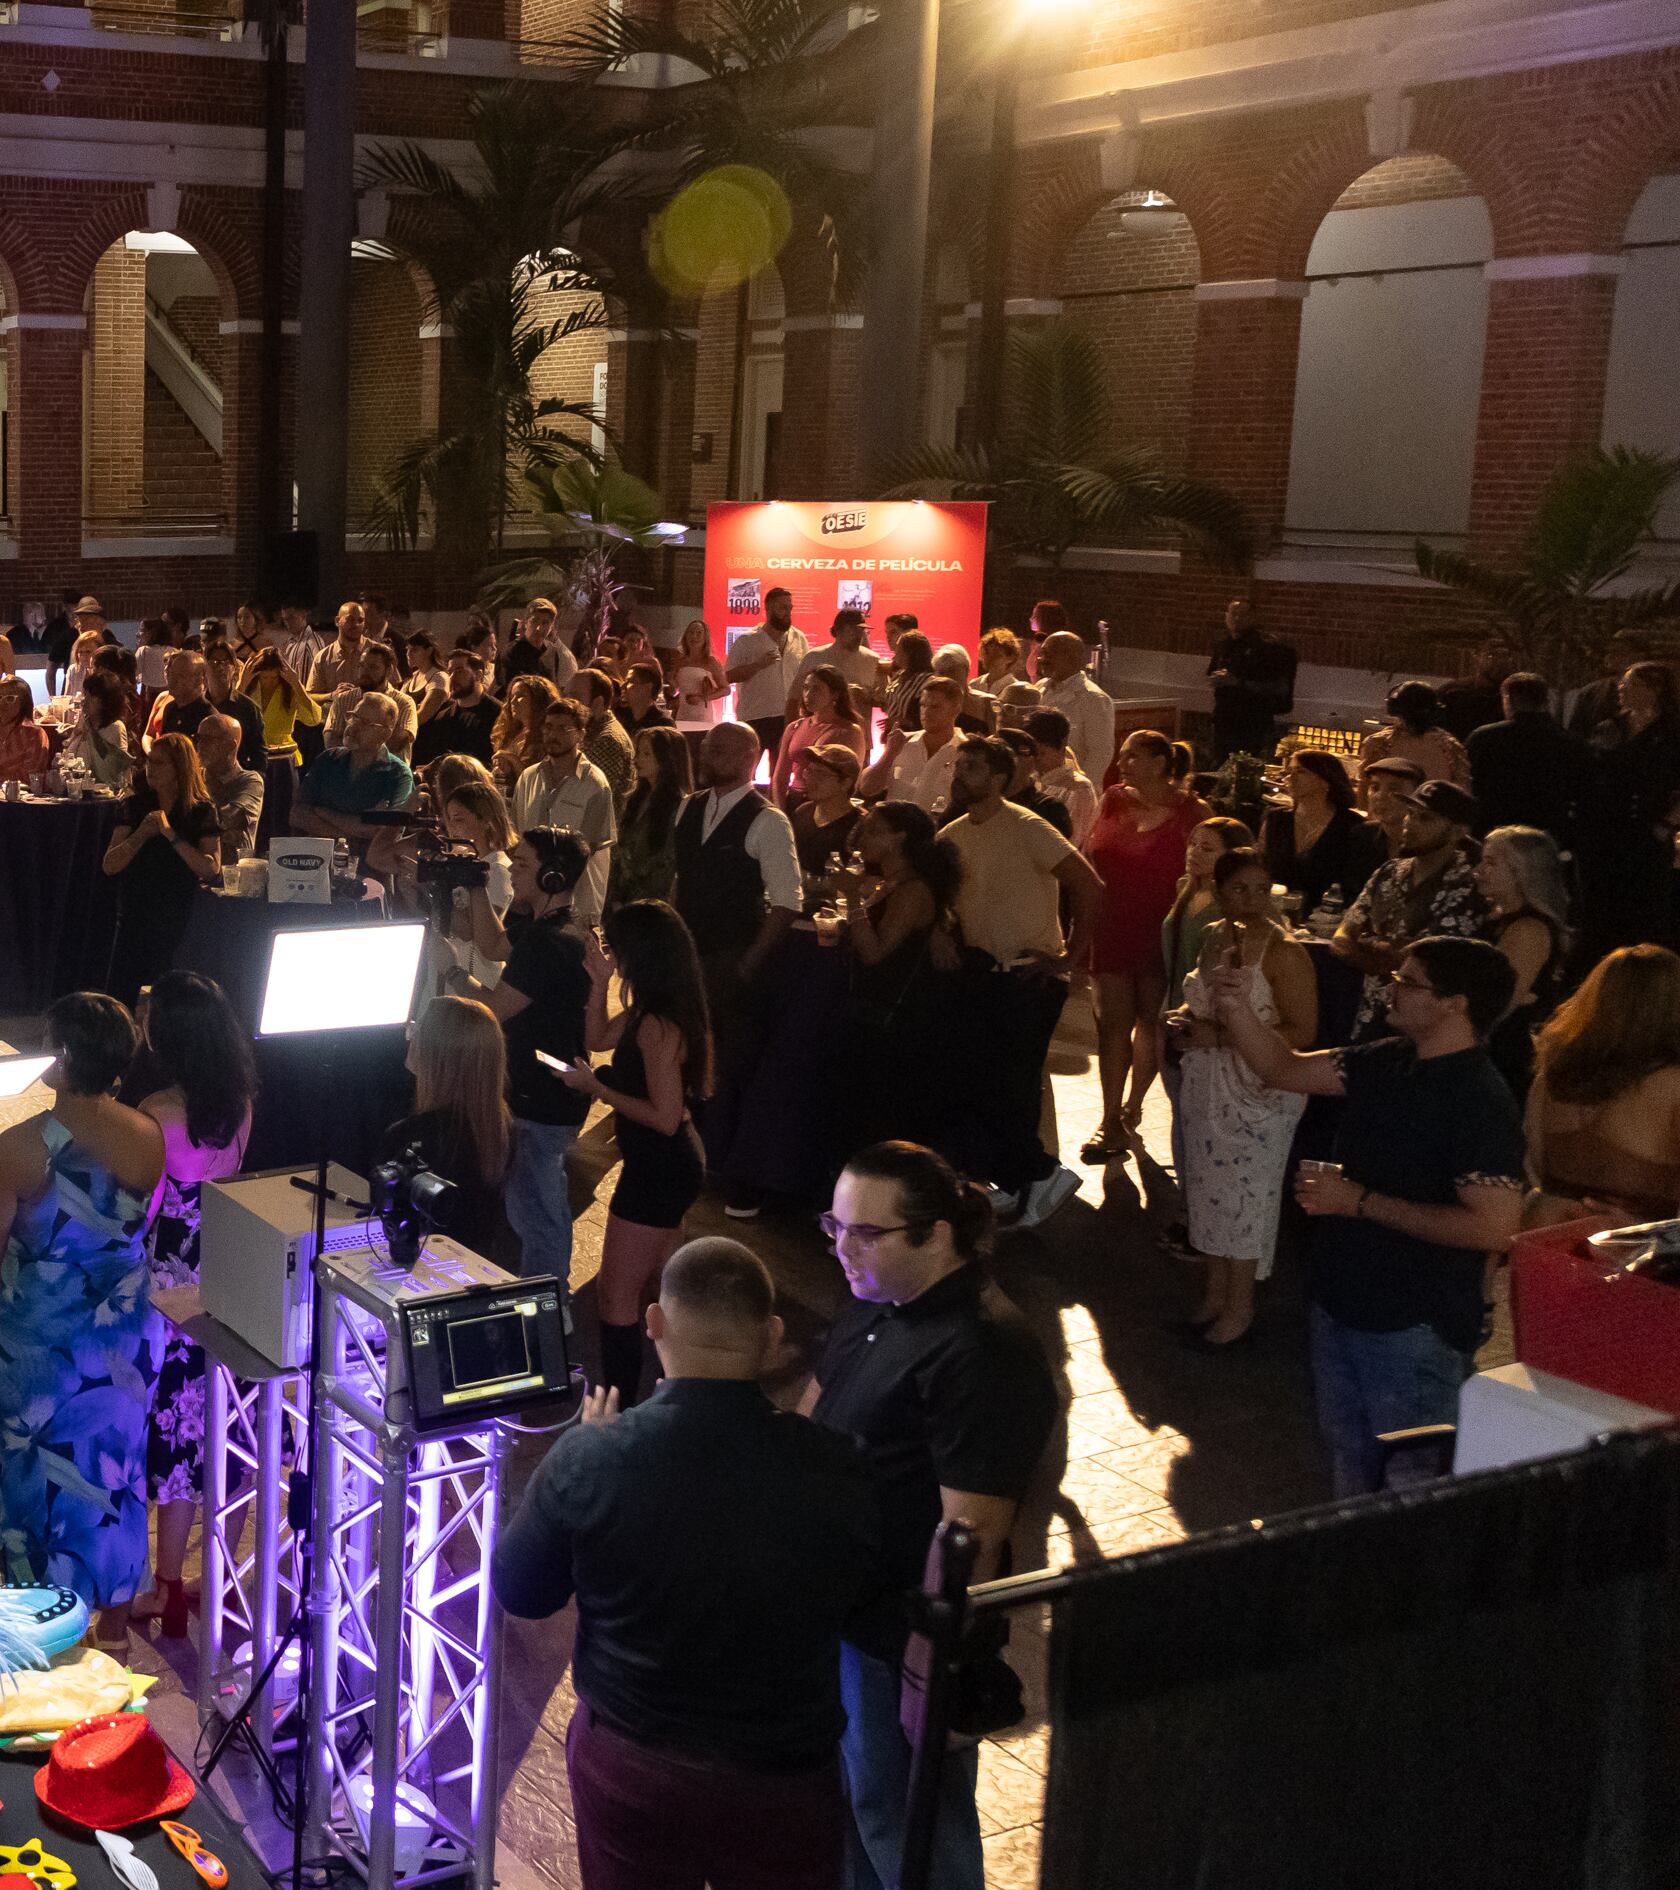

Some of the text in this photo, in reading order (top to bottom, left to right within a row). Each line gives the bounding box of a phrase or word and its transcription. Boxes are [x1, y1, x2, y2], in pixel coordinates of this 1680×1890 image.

[824, 511, 866, 531] OESTE
[767, 558, 849, 569] CERVEZA
[852, 559, 876, 570] DE
[879, 557, 963, 571] PELÍCULA
[281, 858, 321, 867] OLD NAVY
